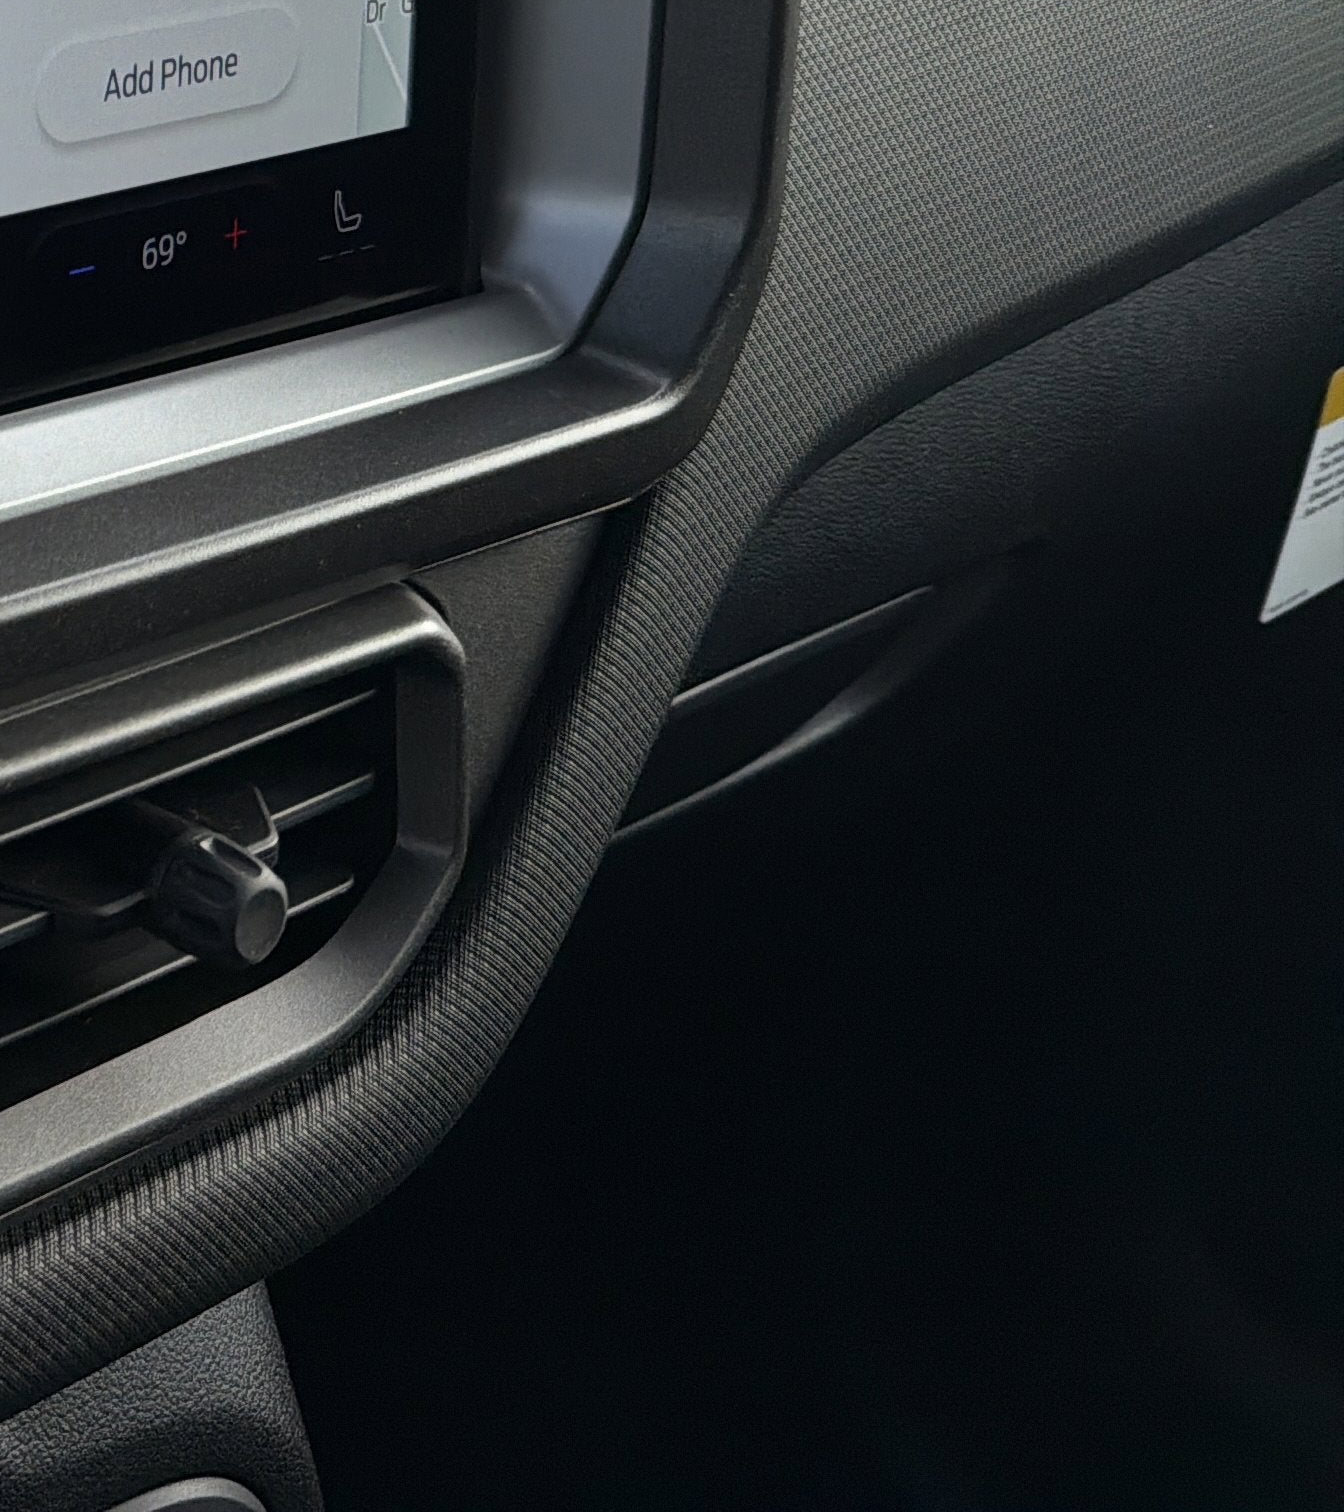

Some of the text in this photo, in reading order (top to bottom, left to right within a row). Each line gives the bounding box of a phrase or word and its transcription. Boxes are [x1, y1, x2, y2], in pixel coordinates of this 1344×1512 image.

[366, 0, 386, 23] Dr
[104, 49, 238, 103] Add Phone
